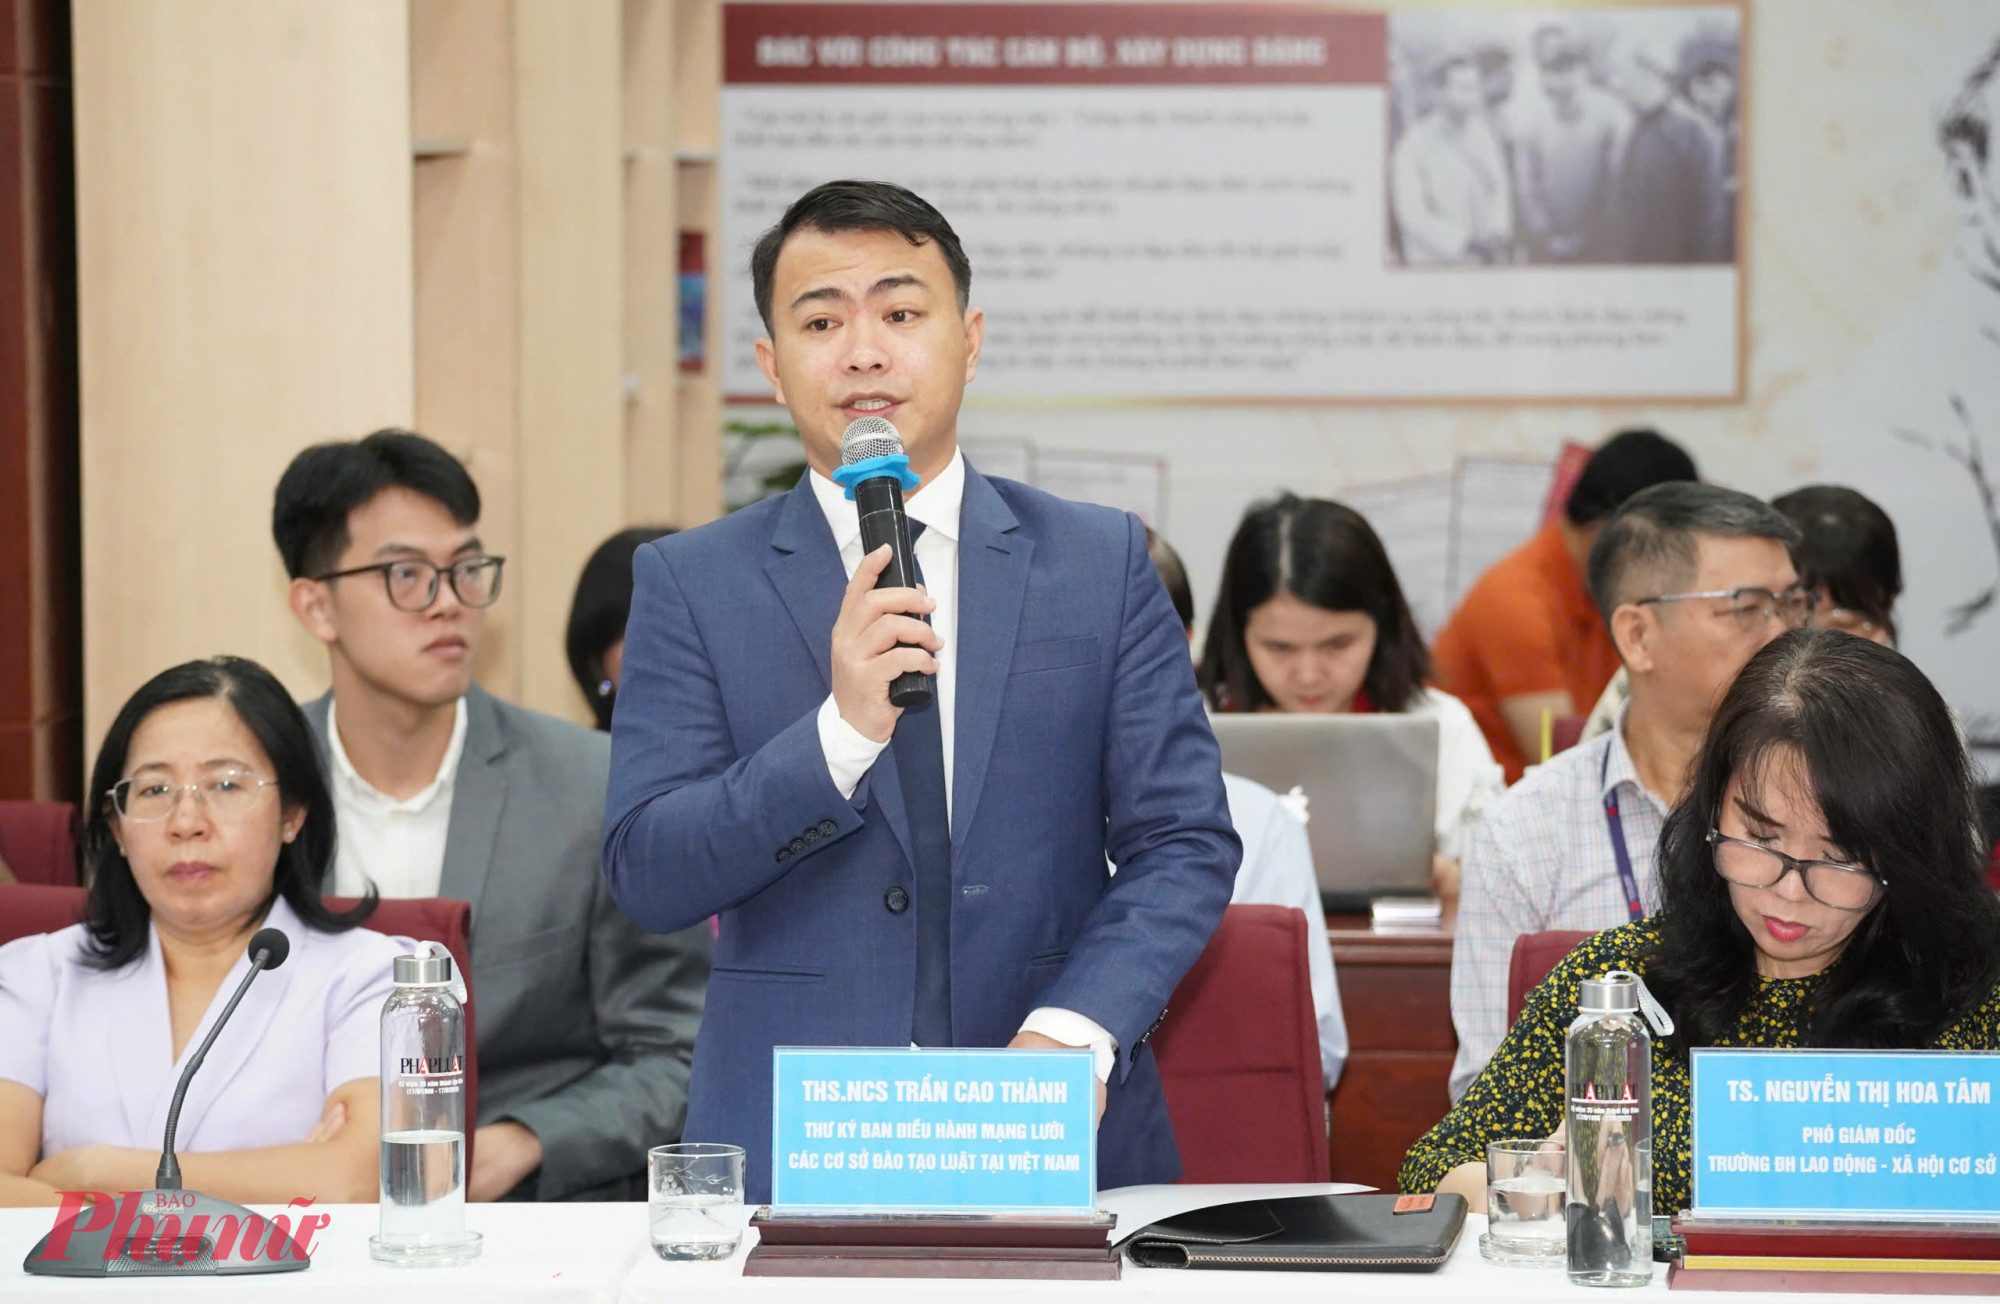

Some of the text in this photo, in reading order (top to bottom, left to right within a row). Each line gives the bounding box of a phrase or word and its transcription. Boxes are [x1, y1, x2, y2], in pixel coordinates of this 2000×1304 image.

[802, 1074, 1067, 1103] THS.NCS TRẦN CAO THÀNH
[1727, 1073, 1990, 1108] TS. NGUYỄN THỊ HOA TÂM
[805, 1118, 1064, 1143] THƯ KÝ BAN ĐIỀU HÀNH MẠNG LƯỚI
[1803, 1122, 1916, 1144] PHÓ GIÁM ĐỐC
[789, 1148, 1080, 1173] CÁC CƠ SỞ ĐÀO TẠO LUẬT TẠI VIỆT NAM
[1708, 1152, 1770, 1172] TRƯỜNG
[1774, 1156, 1796, 1172] ĐH
[1800, 1156, 1829, 1173] LAO
[1833, 1154, 1876, 1176] ĐỘNG
[1892, 1154, 1913, 1173] XÃ
[1918, 1154, 1944, 1177] HỘI
[1949, 1156, 1970, 1174] CƠ
[1975, 1153, 1997, 1174] SỞ
